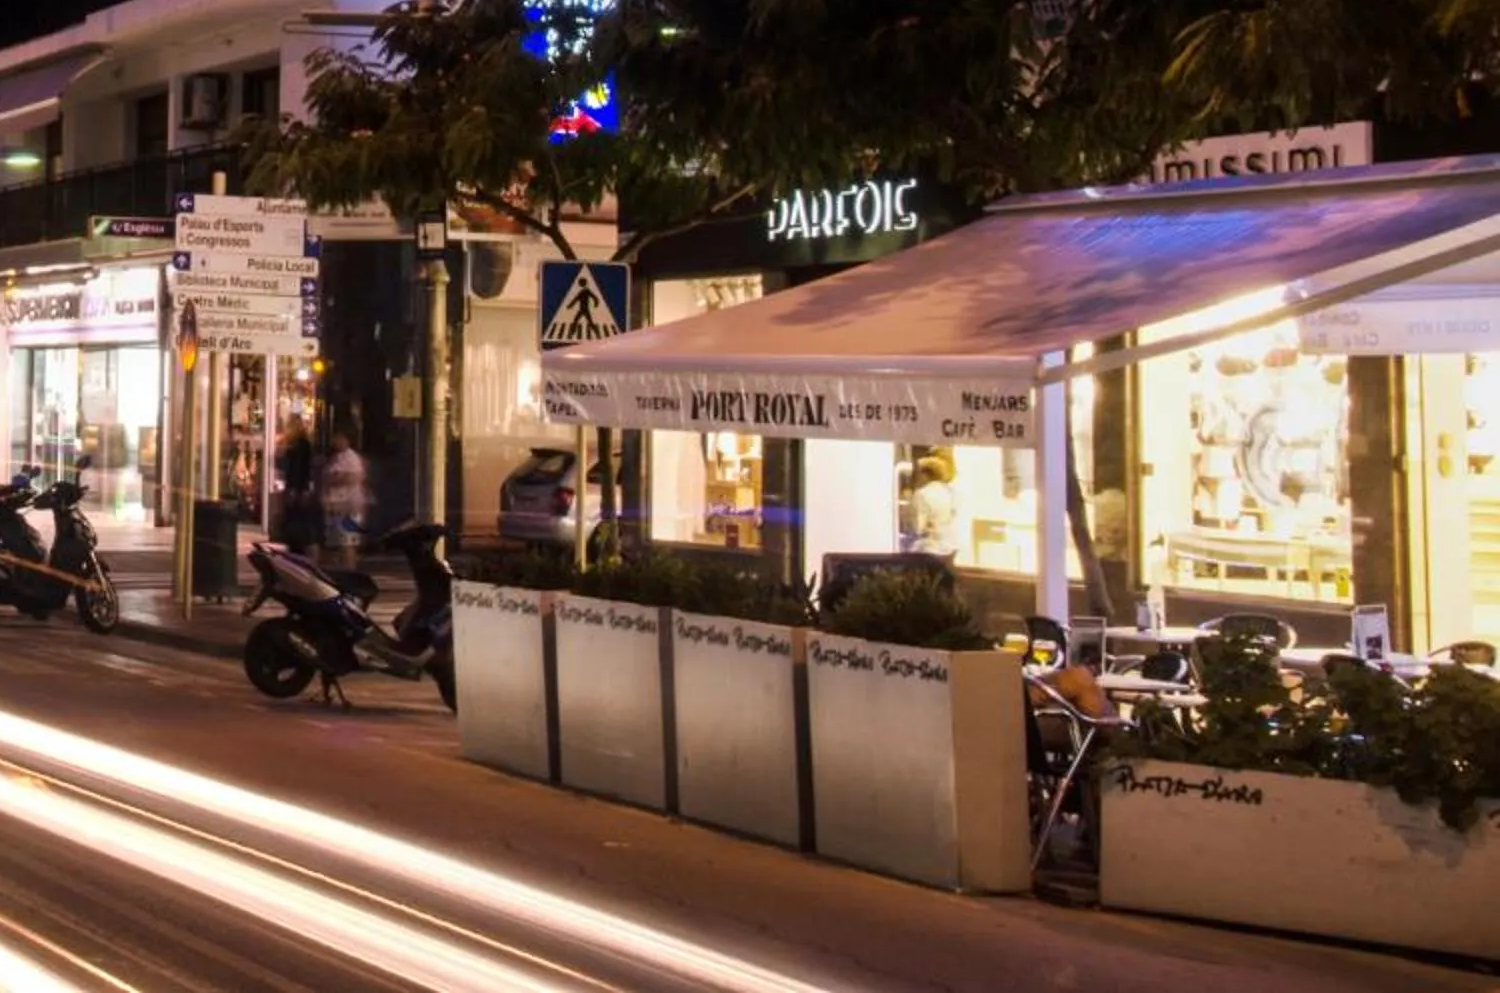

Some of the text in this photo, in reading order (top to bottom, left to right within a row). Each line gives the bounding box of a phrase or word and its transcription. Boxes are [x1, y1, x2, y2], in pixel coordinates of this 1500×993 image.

[767, 177, 918, 243] PARFOIS
[185, 232, 251, 249] Congressos
[285, 259, 315, 273] Local
[691, 390, 749, 423] PORT
[753, 392, 830, 428] ROYAL
[961, 391, 1028, 413] MENJARS
[992, 419, 1025, 438] BAR
